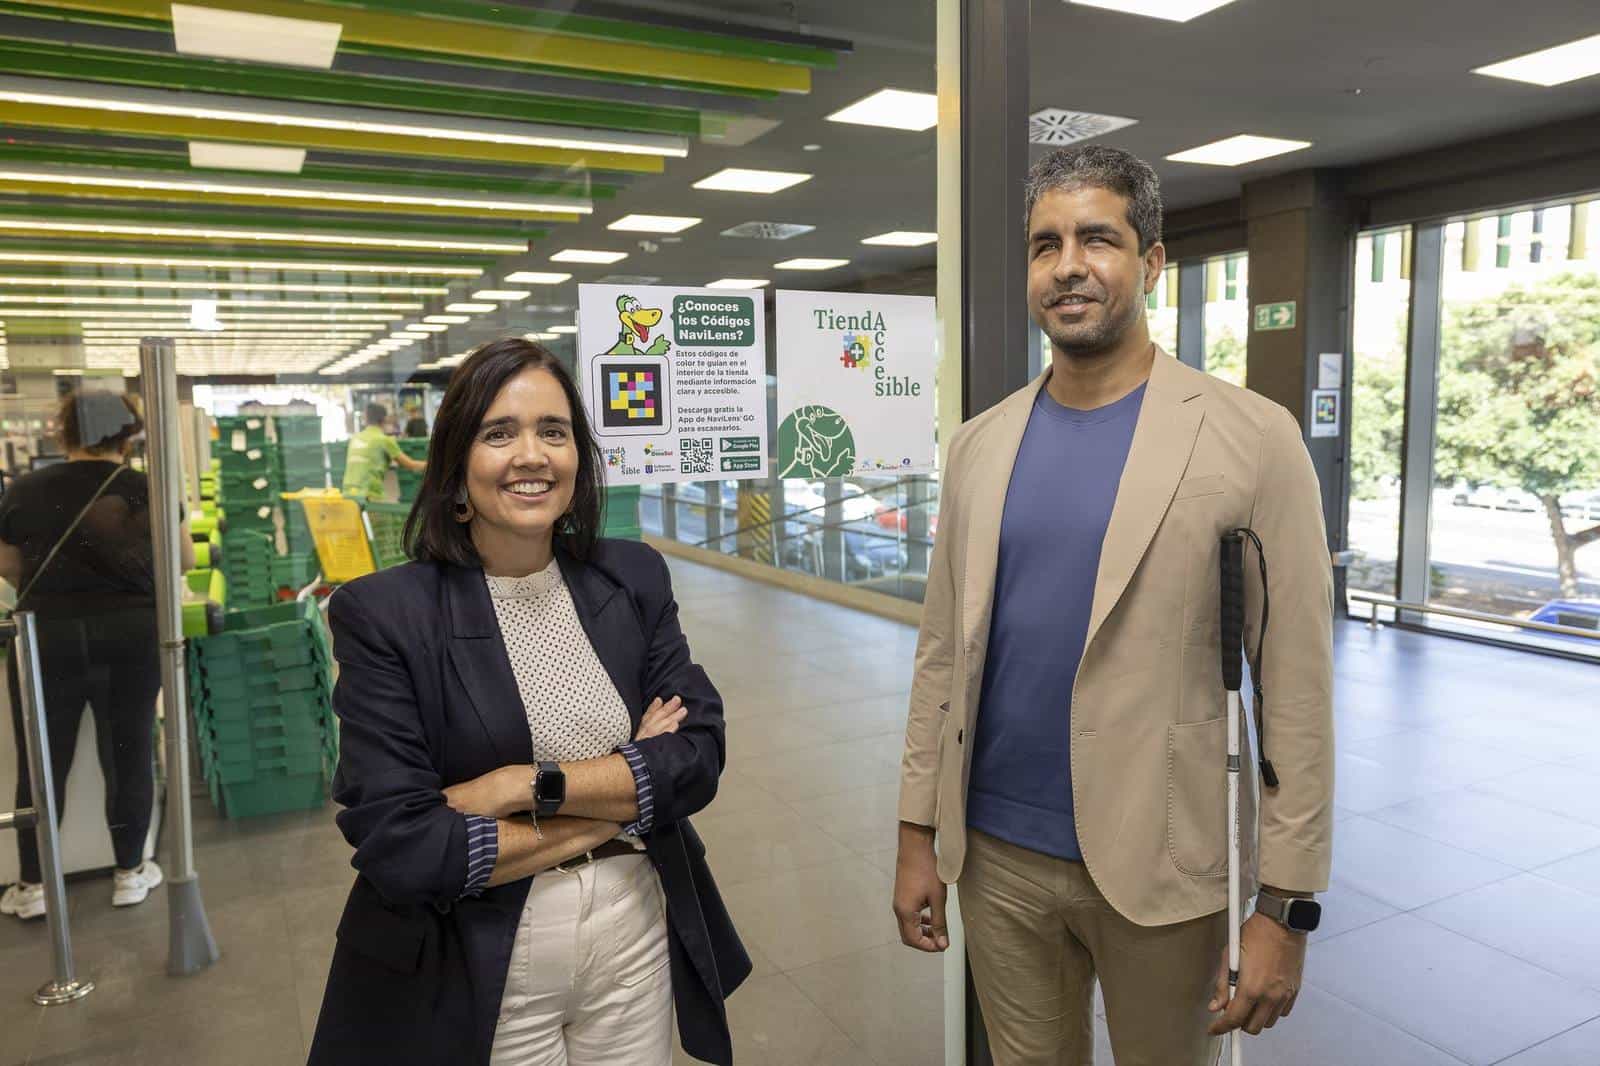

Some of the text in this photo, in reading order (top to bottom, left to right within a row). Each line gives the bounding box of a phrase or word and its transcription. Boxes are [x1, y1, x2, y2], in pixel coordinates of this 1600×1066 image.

[678, 300, 738, 312] ¿Conoces
[679, 316, 751, 327] los Códigos
[680, 330, 743, 340] NaviLens?
[875, 377, 920, 396] sible
[715, 406, 734, 414] gratis
[678, 416, 694, 424] App
